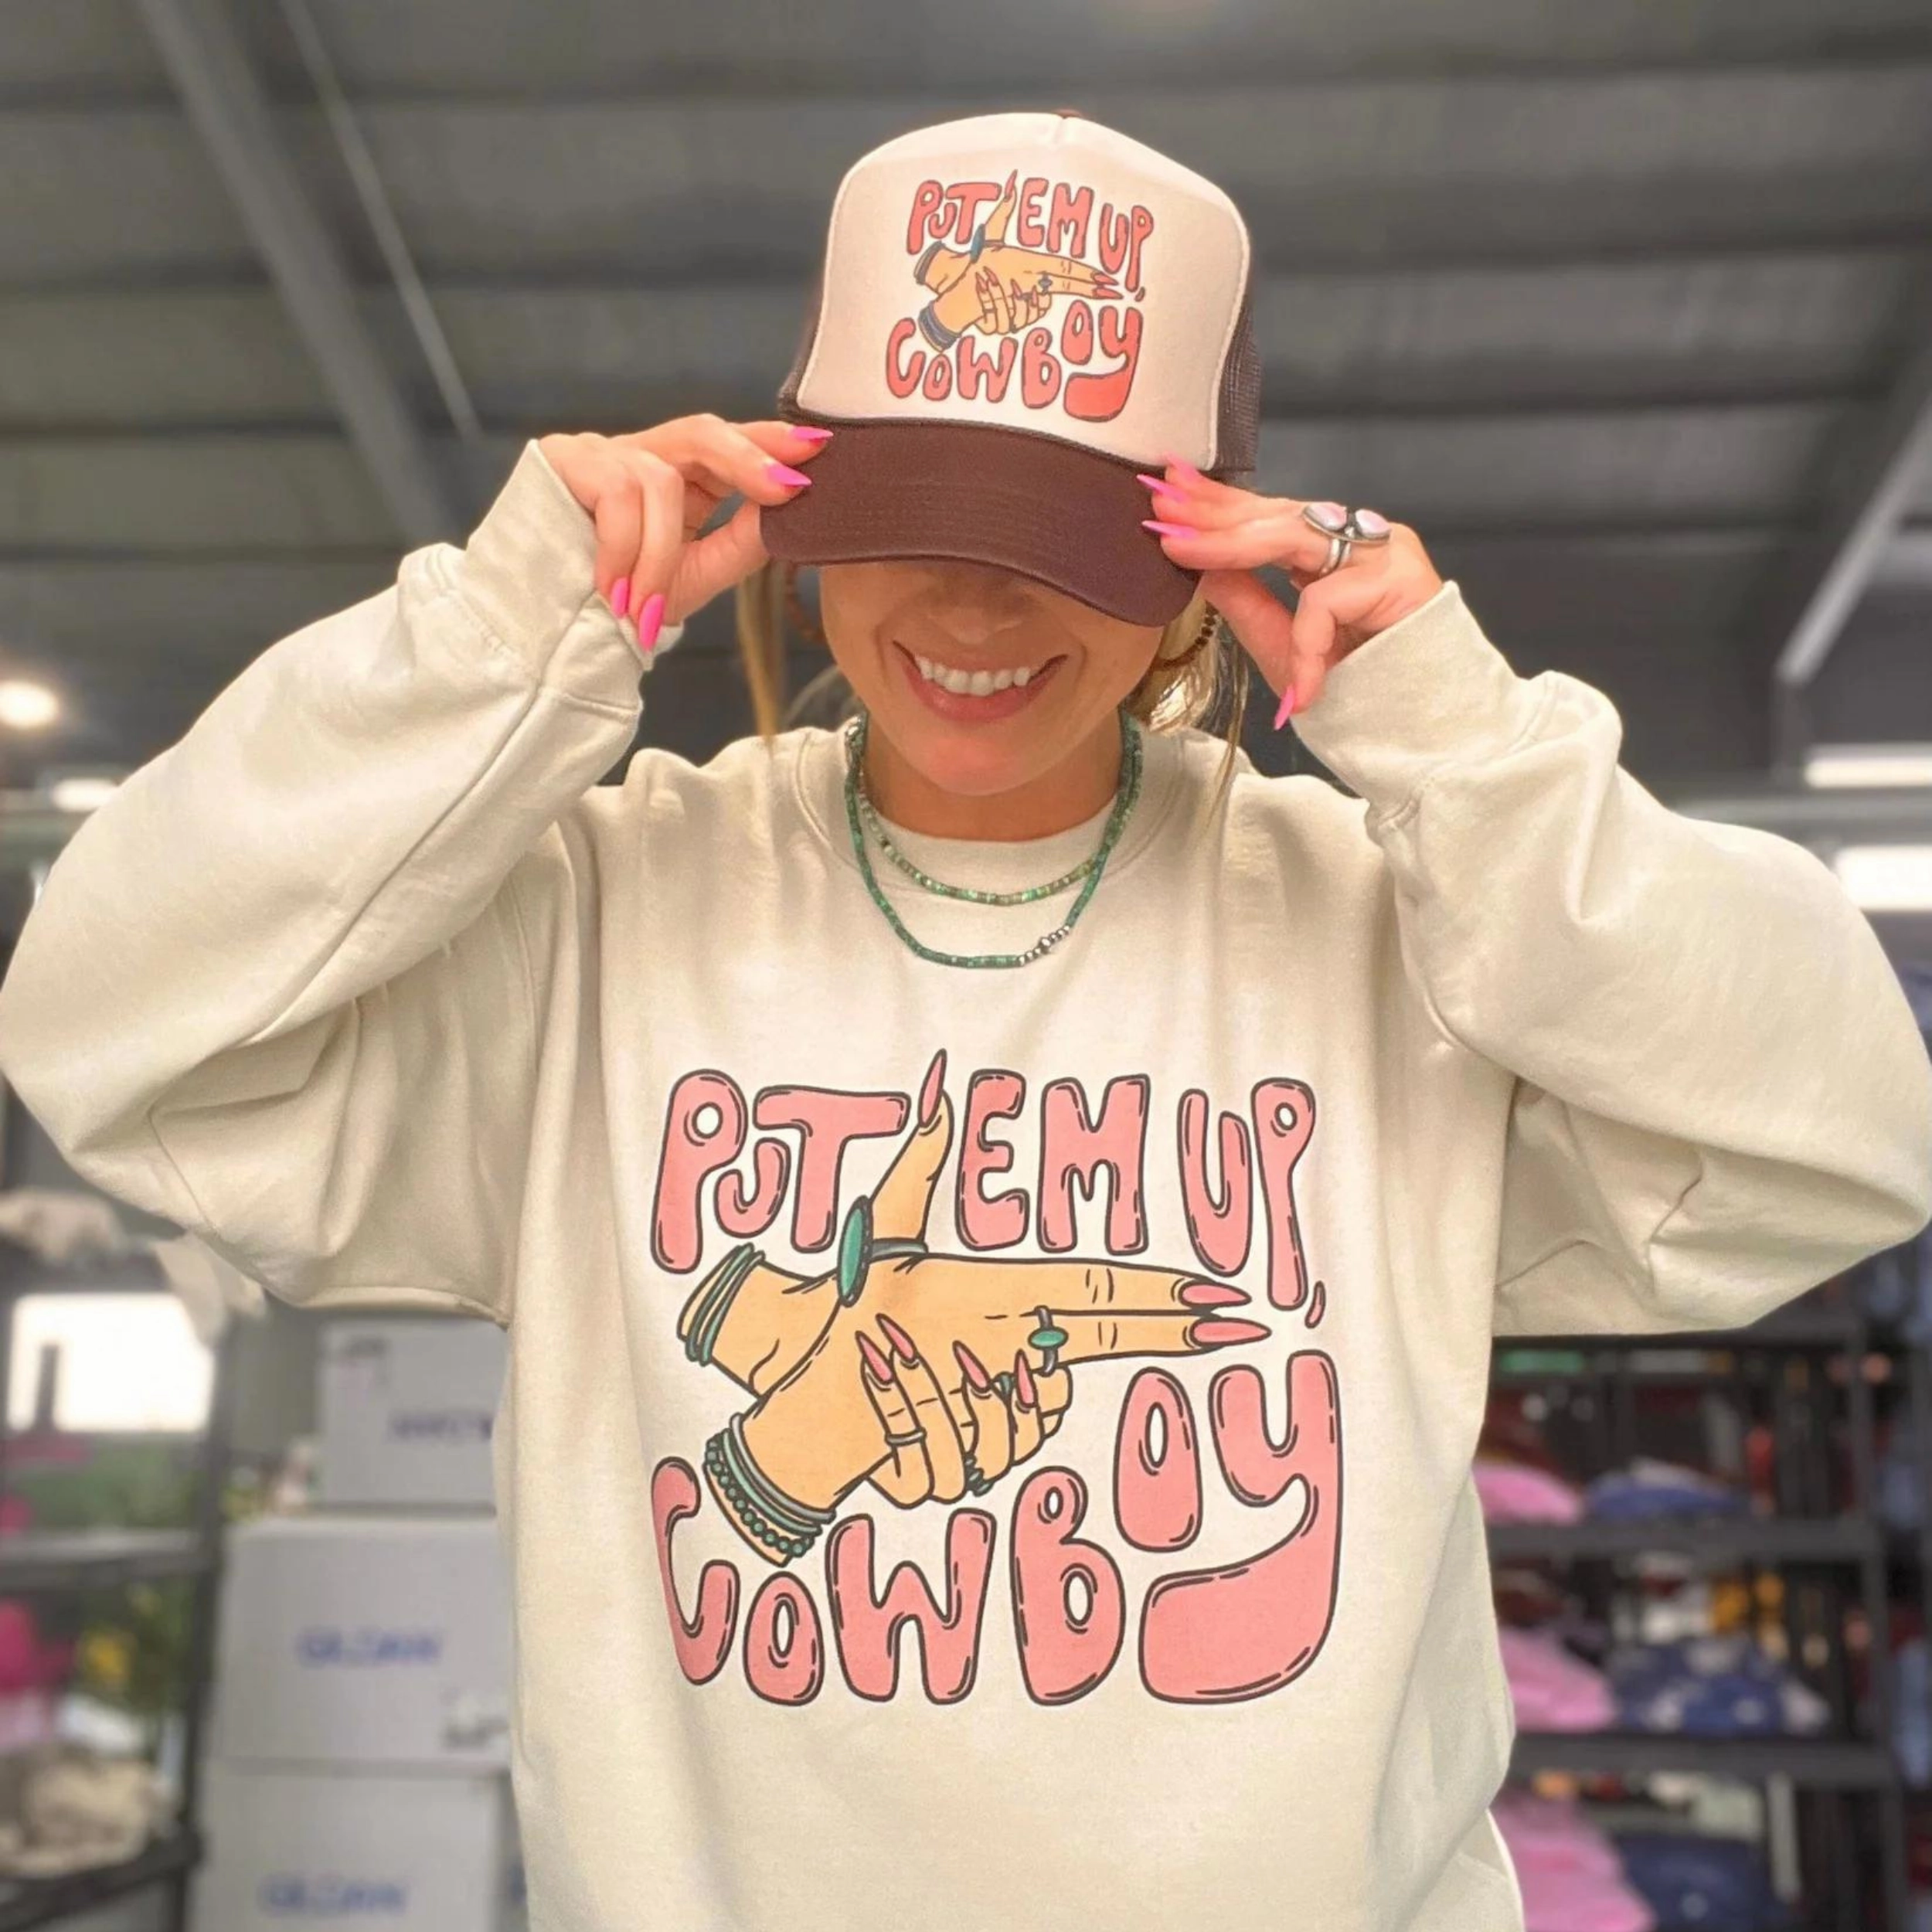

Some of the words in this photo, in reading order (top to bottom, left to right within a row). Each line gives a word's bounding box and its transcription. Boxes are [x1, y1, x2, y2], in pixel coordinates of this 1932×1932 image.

[906, 179, 1002, 255] PUT
[886, 300, 1144, 422] COWBOY
[651, 1070, 911, 1274] PUT
[651, 1350, 1343, 1706] COWBOY
